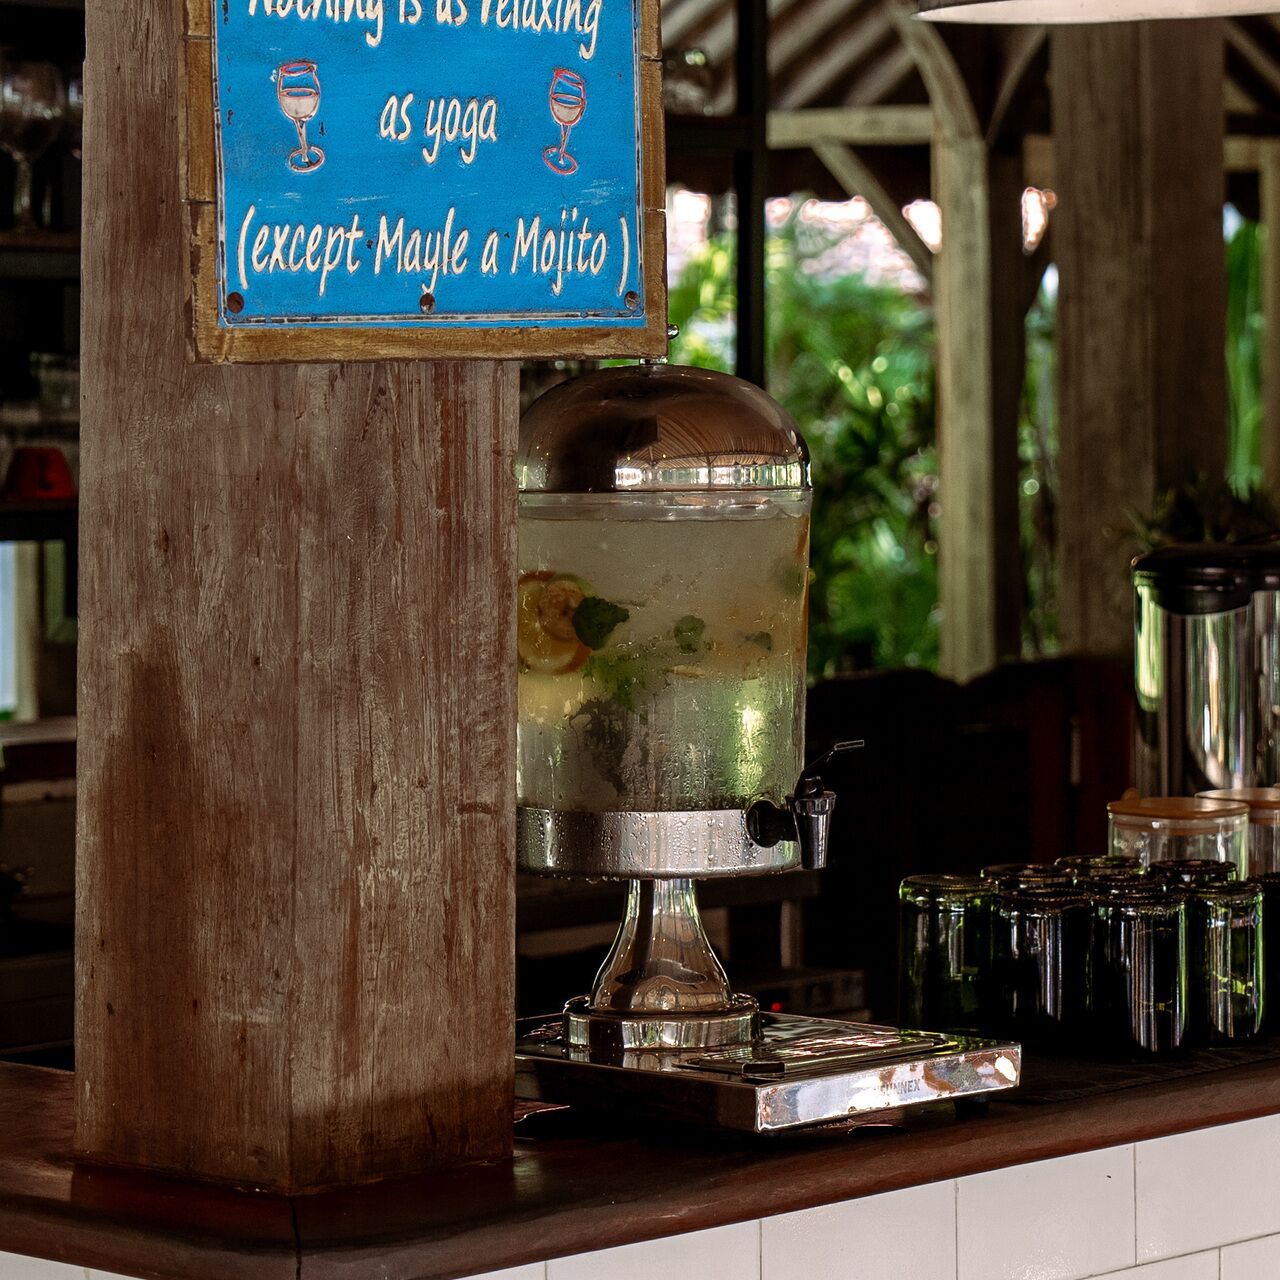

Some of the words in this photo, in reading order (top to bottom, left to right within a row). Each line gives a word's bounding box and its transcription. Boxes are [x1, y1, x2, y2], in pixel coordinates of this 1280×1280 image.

[380, 93, 414, 141] as
[422, 98, 498, 165] yoga
[236, 204, 364, 297] (except
[481, 230, 499, 276] a
[511, 207, 608, 296] Mojito
